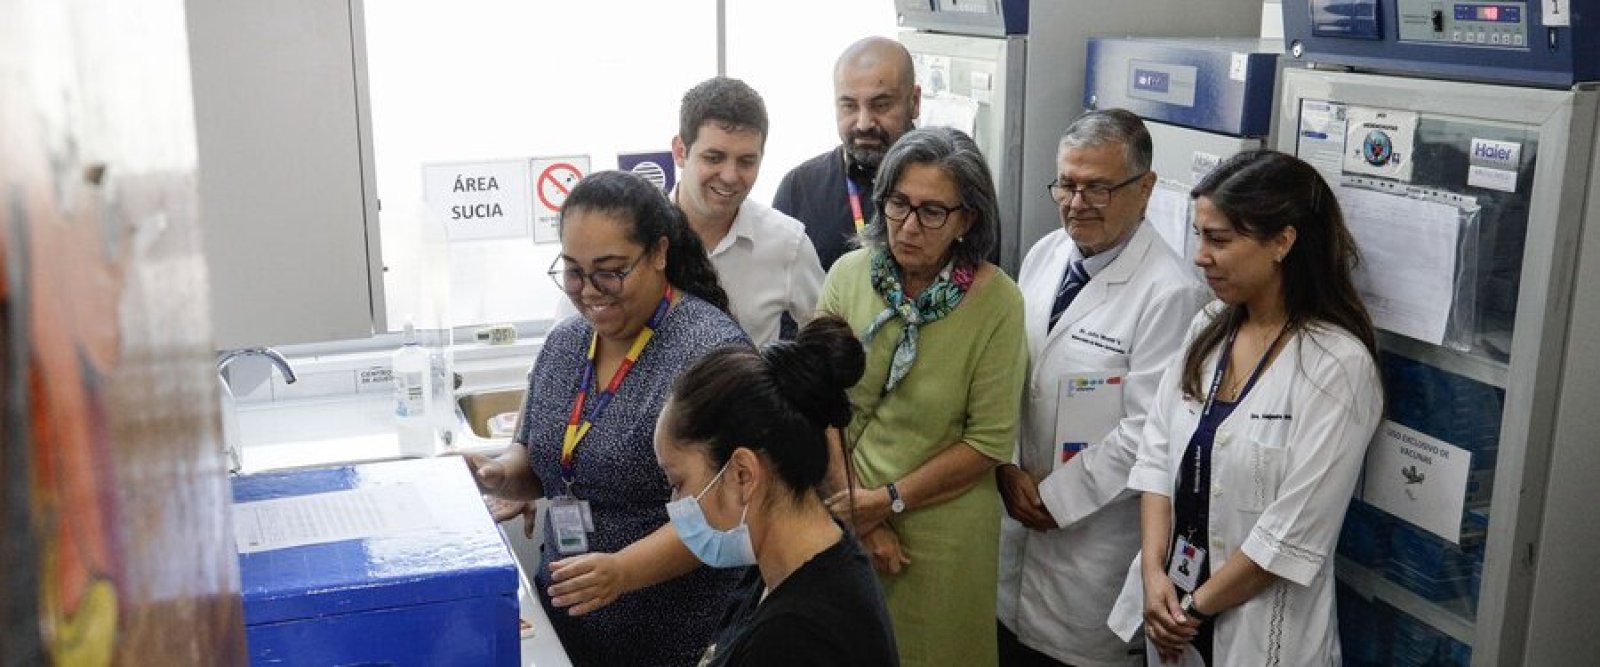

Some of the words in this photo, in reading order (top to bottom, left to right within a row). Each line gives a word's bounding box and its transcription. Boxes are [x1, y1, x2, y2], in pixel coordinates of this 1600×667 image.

[1475, 142, 1512, 160] Haier
[453, 174, 499, 193] ÁREA
[451, 203, 504, 220] SUCIA
